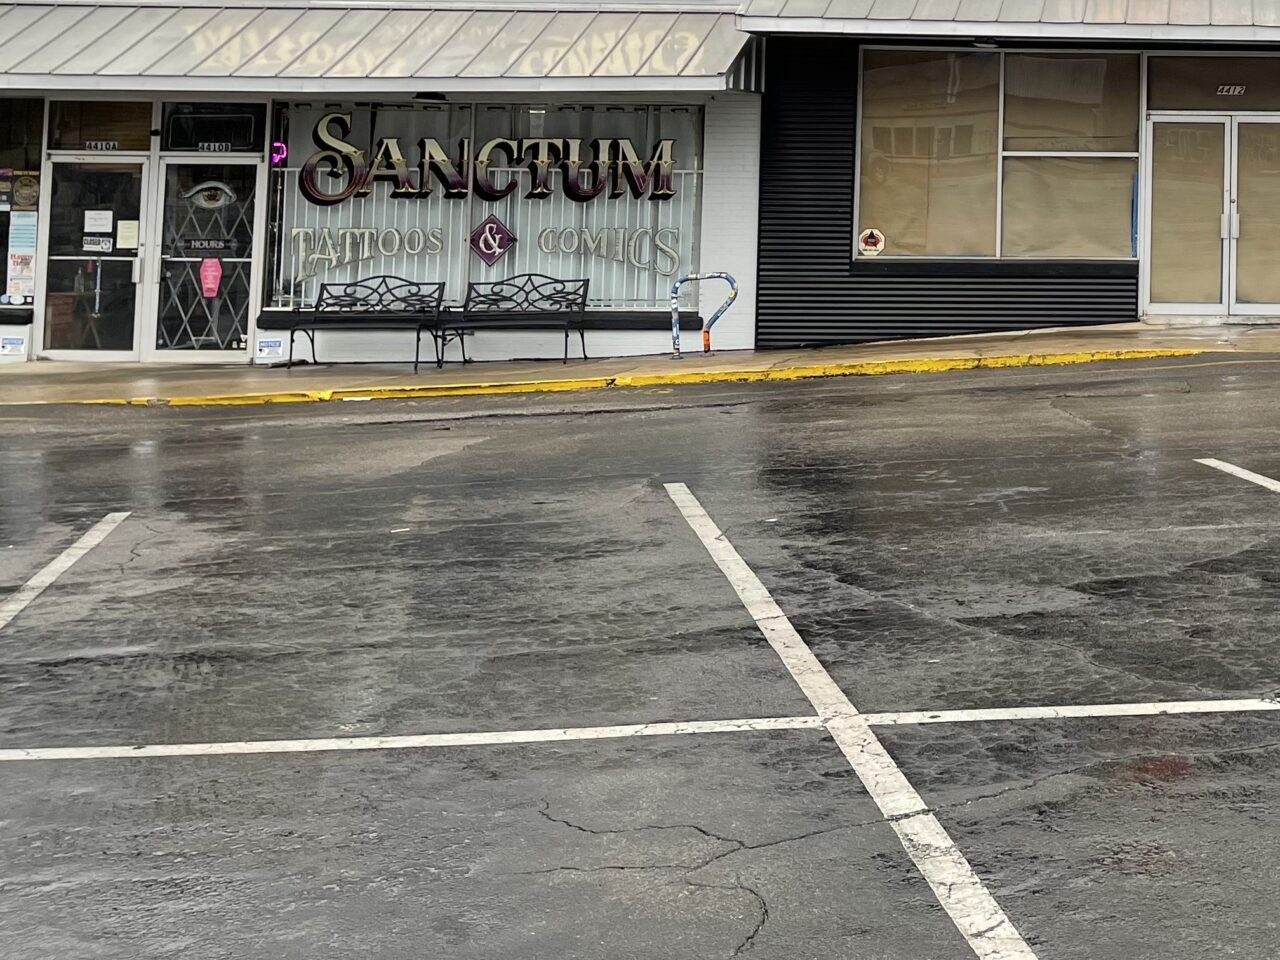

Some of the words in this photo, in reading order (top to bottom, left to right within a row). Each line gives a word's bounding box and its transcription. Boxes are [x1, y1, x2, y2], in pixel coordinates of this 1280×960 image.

[299, 111, 678, 207] SANCTUM
[191, 240, 225, 249] HOURS
[291, 227, 443, 283] TATTOOS
[479, 223, 504, 256] &
[538, 226, 681, 276] COMICS
